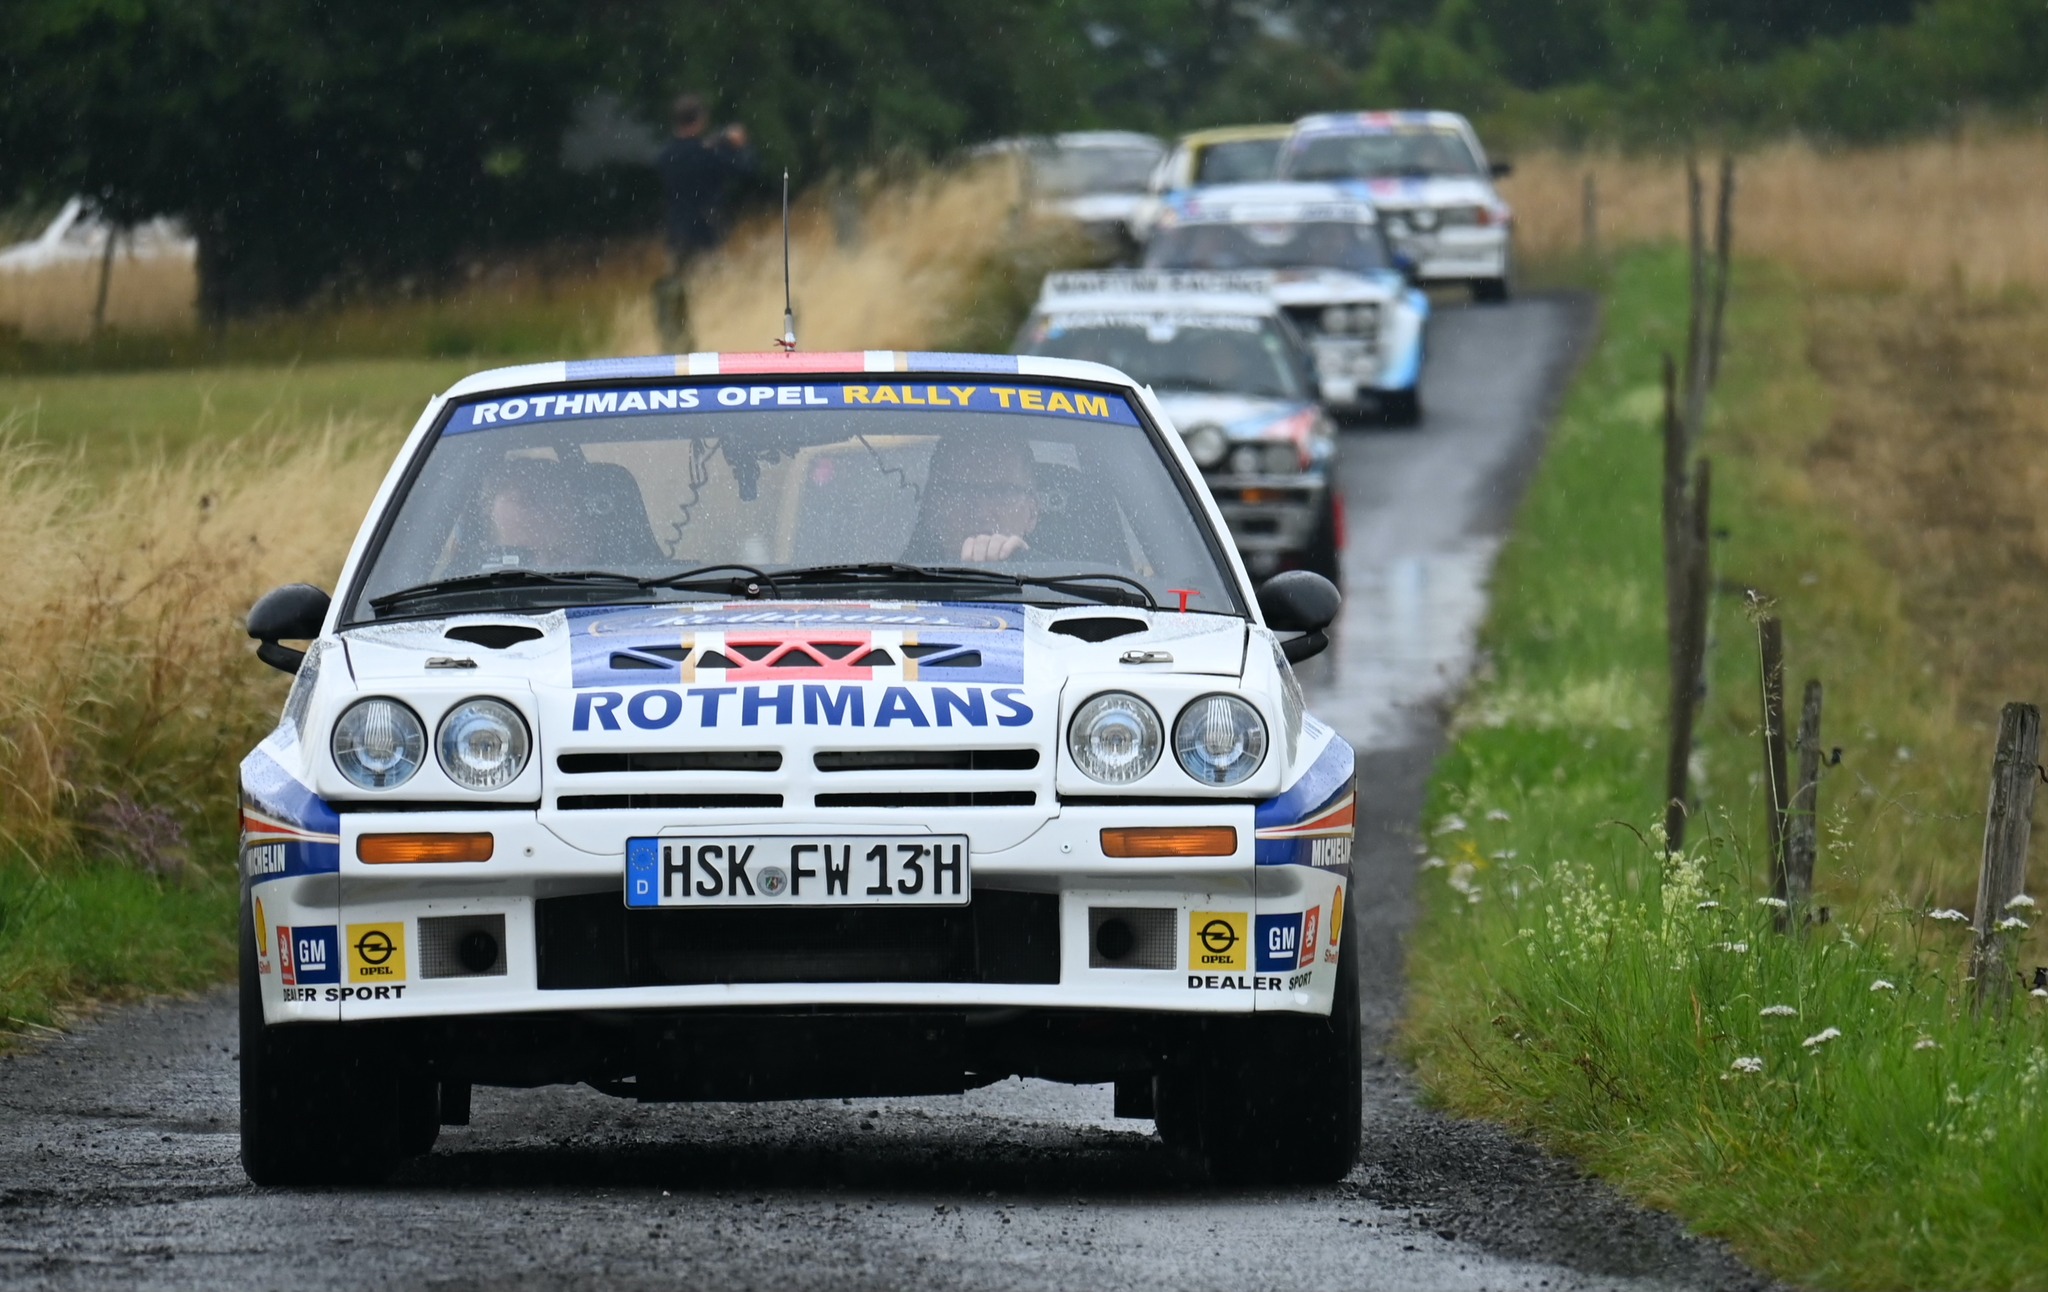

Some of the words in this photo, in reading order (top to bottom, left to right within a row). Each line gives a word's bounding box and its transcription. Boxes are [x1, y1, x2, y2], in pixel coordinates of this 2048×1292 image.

[472, 388, 700, 425] ROTHMANS
[717, 386, 829, 406] OPEL
[842, 385, 977, 406] RALLY
[989, 387, 1110, 418] TEAM
[572, 684, 1034, 731] ROTHMANS
[663, 845, 756, 897] HSK
[791, 844, 850, 896] FW
[866, 844, 961, 896] 13H
[637, 880, 649, 895] D
[1269, 926, 1295, 951] GM
[299, 939, 326, 963] GM
[1201, 955, 1234, 964] OPEL
[360, 966, 393, 976] OPEL
[1188, 975, 1282, 992] DEALER
[1289, 971, 1312, 991] SPORT
[283, 988, 317, 1002] DEALER
[325, 985, 406, 1002] SPORT
